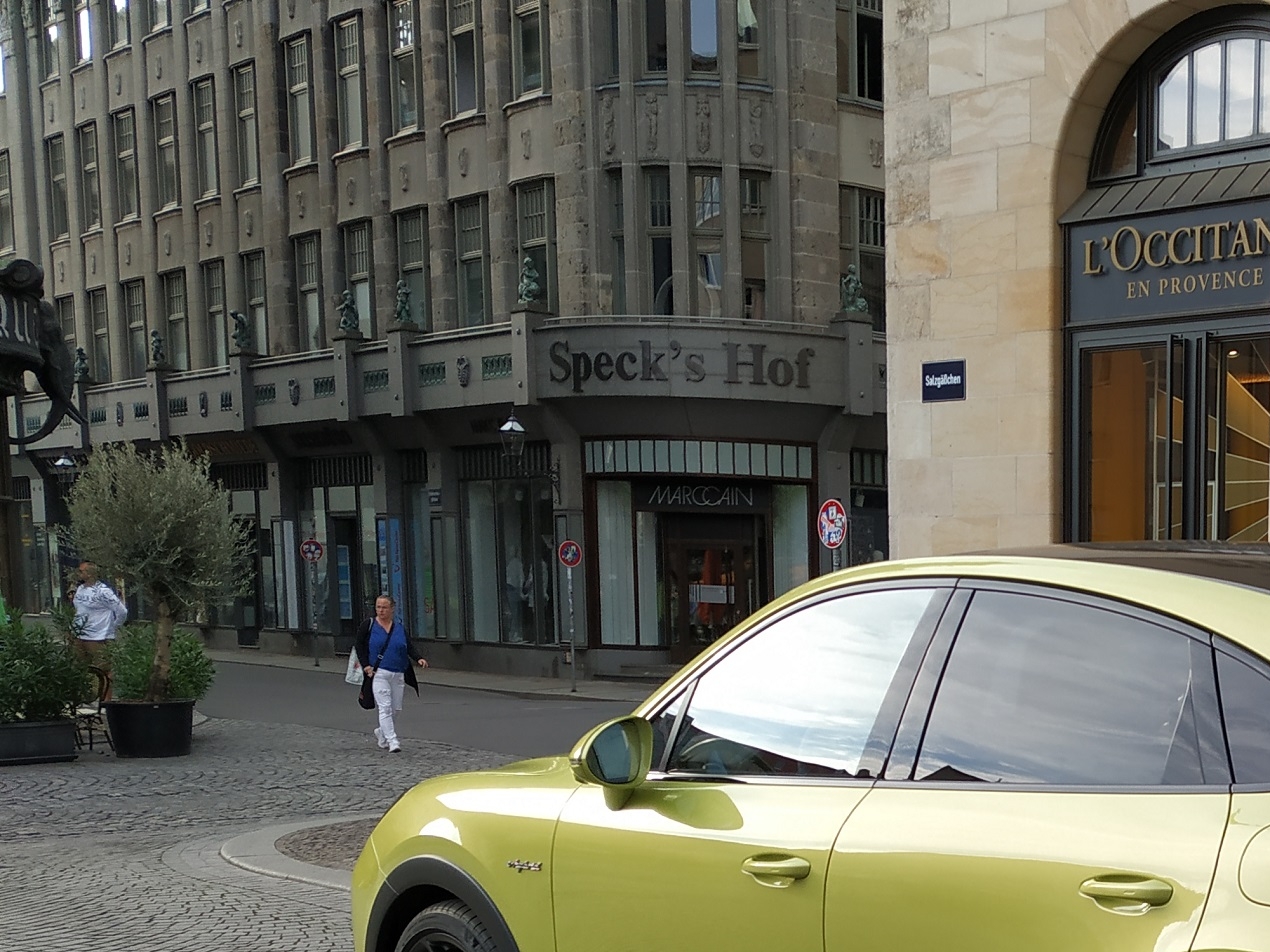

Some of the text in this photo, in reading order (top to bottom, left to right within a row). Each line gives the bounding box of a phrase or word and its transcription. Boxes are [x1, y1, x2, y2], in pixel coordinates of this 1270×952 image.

[1126, 267, 1264, 299] EN PROVENCE
[549, 339, 816, 393] Speck's Hof
